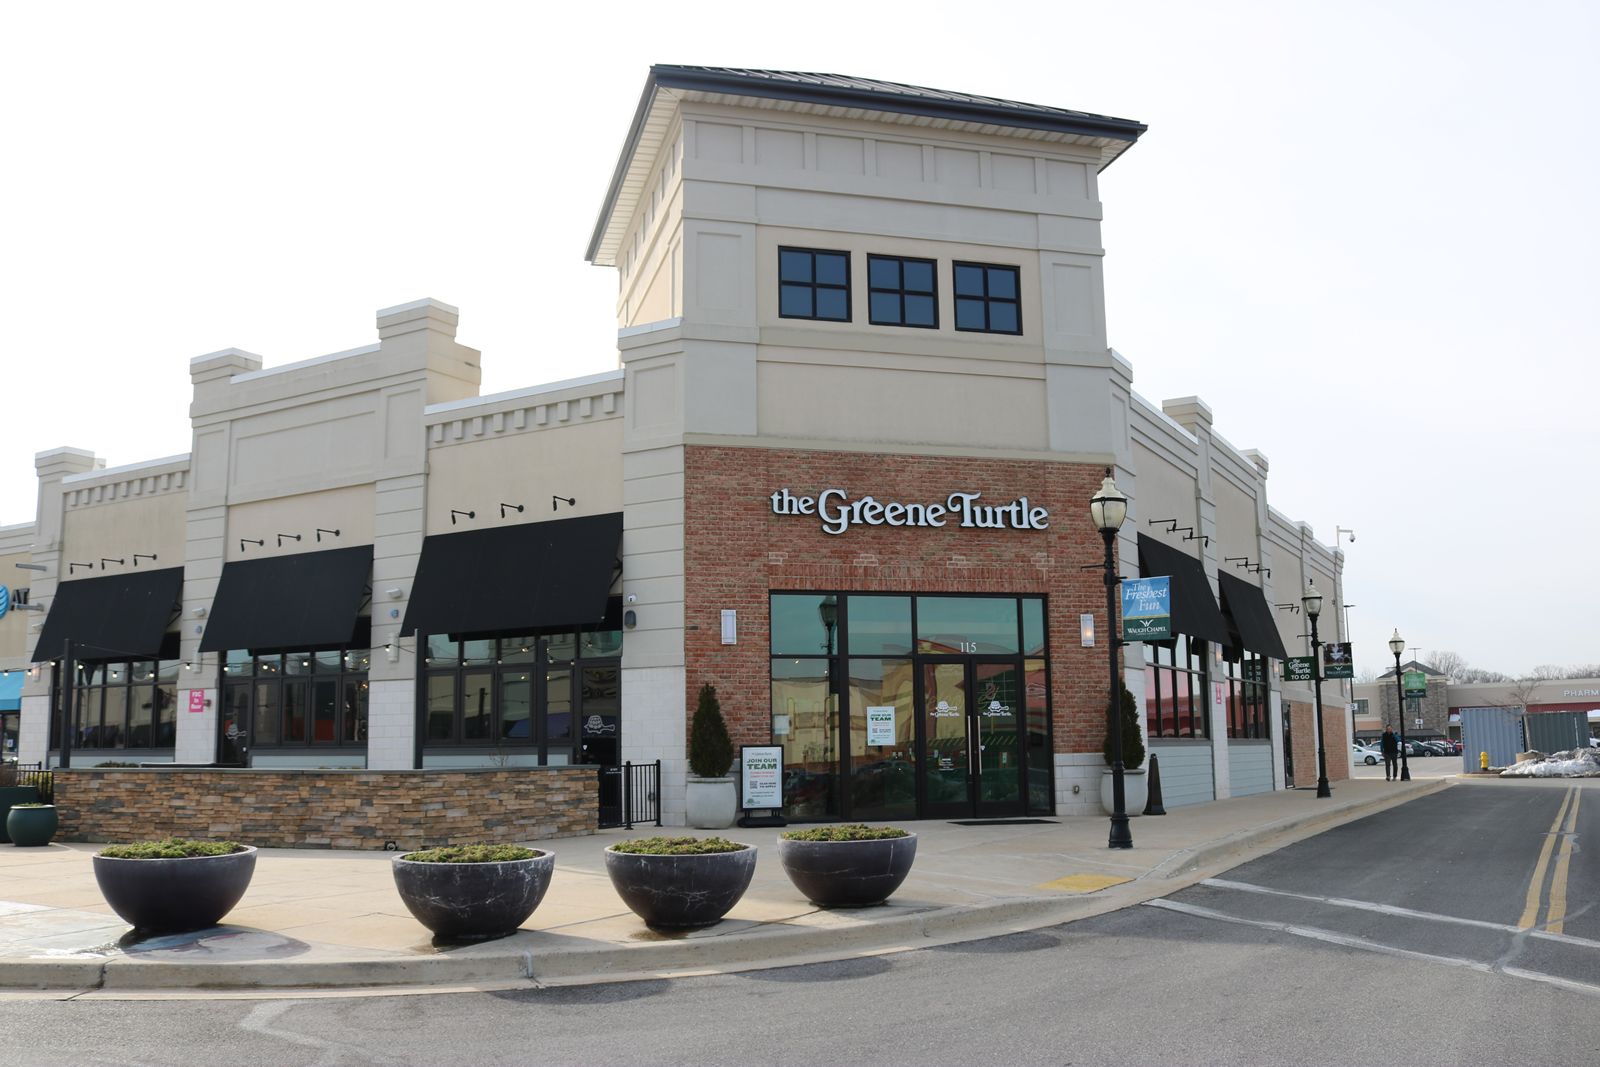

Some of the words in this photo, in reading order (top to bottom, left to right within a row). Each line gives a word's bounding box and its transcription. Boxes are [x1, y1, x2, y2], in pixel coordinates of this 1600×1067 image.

[770, 488, 815, 515] the
[818, 488, 947, 535] Greene
[947, 491, 1049, 530] Turtle
[1132, 583, 1147, 591] The
[1125, 587, 1168, 600] Freshest
[1139, 600, 1160, 611] Fun
[960, 642, 977, 653] 115
[1288, 661, 1310, 670] Greene
